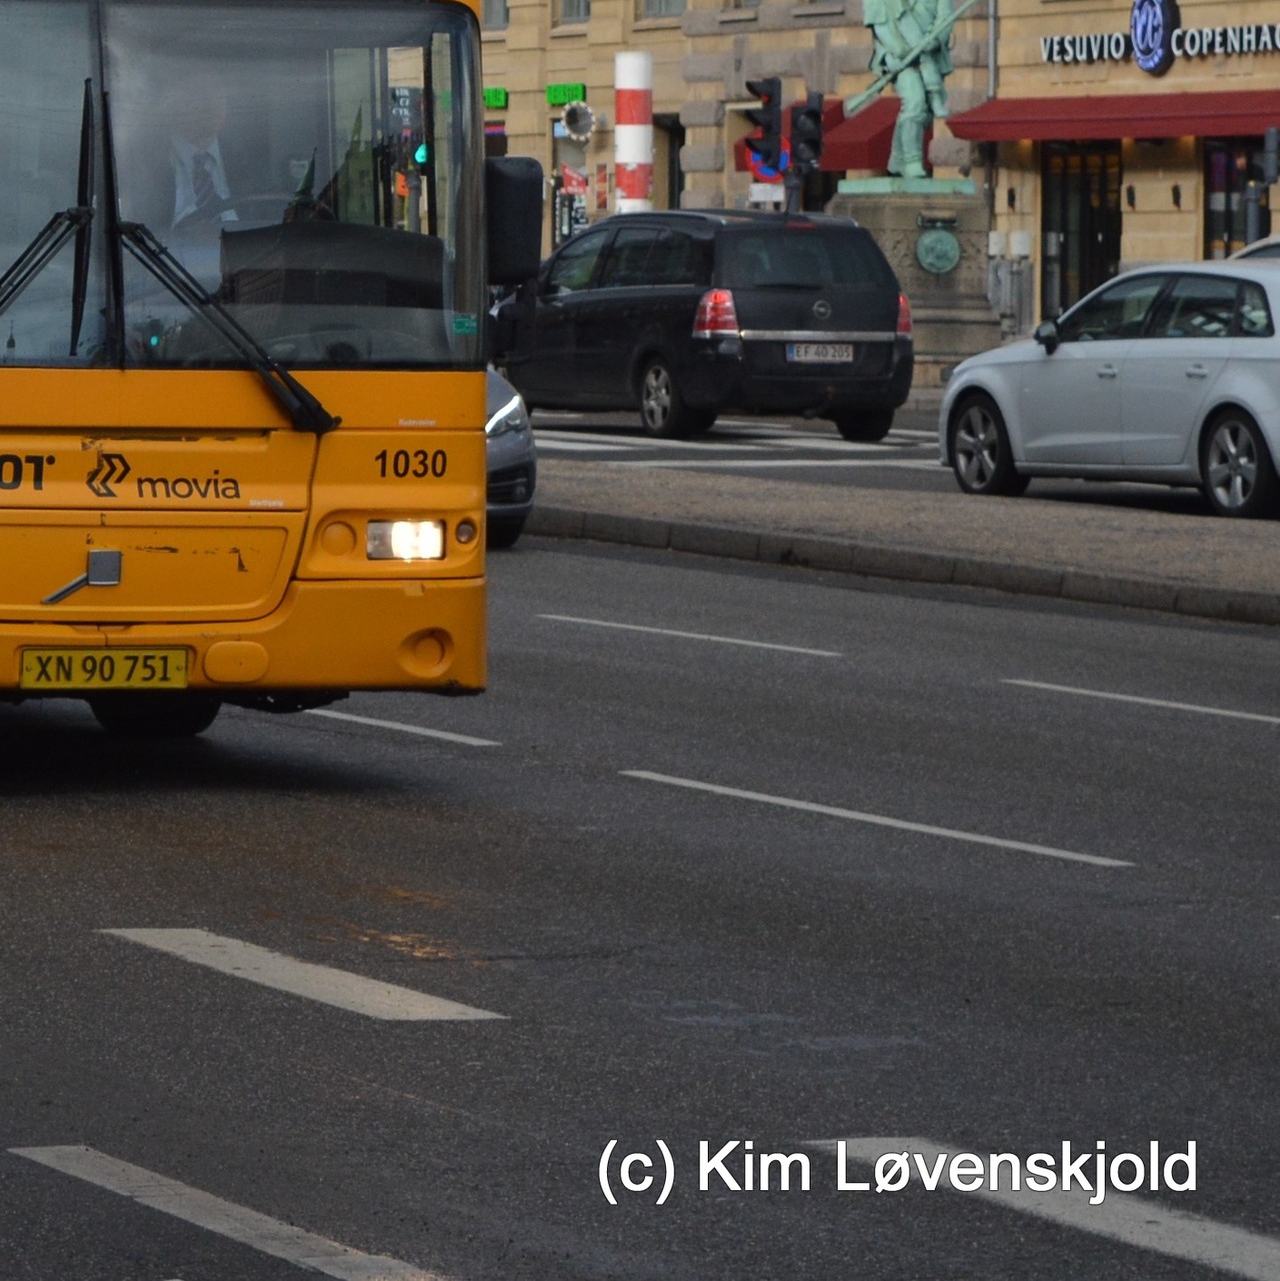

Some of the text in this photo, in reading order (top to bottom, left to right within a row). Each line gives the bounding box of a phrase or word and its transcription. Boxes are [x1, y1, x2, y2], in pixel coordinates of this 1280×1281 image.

[1040, 32, 1125, 62] VESUVIO
[374, 449, 447, 478] 1030
[137, 469, 240, 499] movia
[36, 655, 171, 682] XN 90 751
